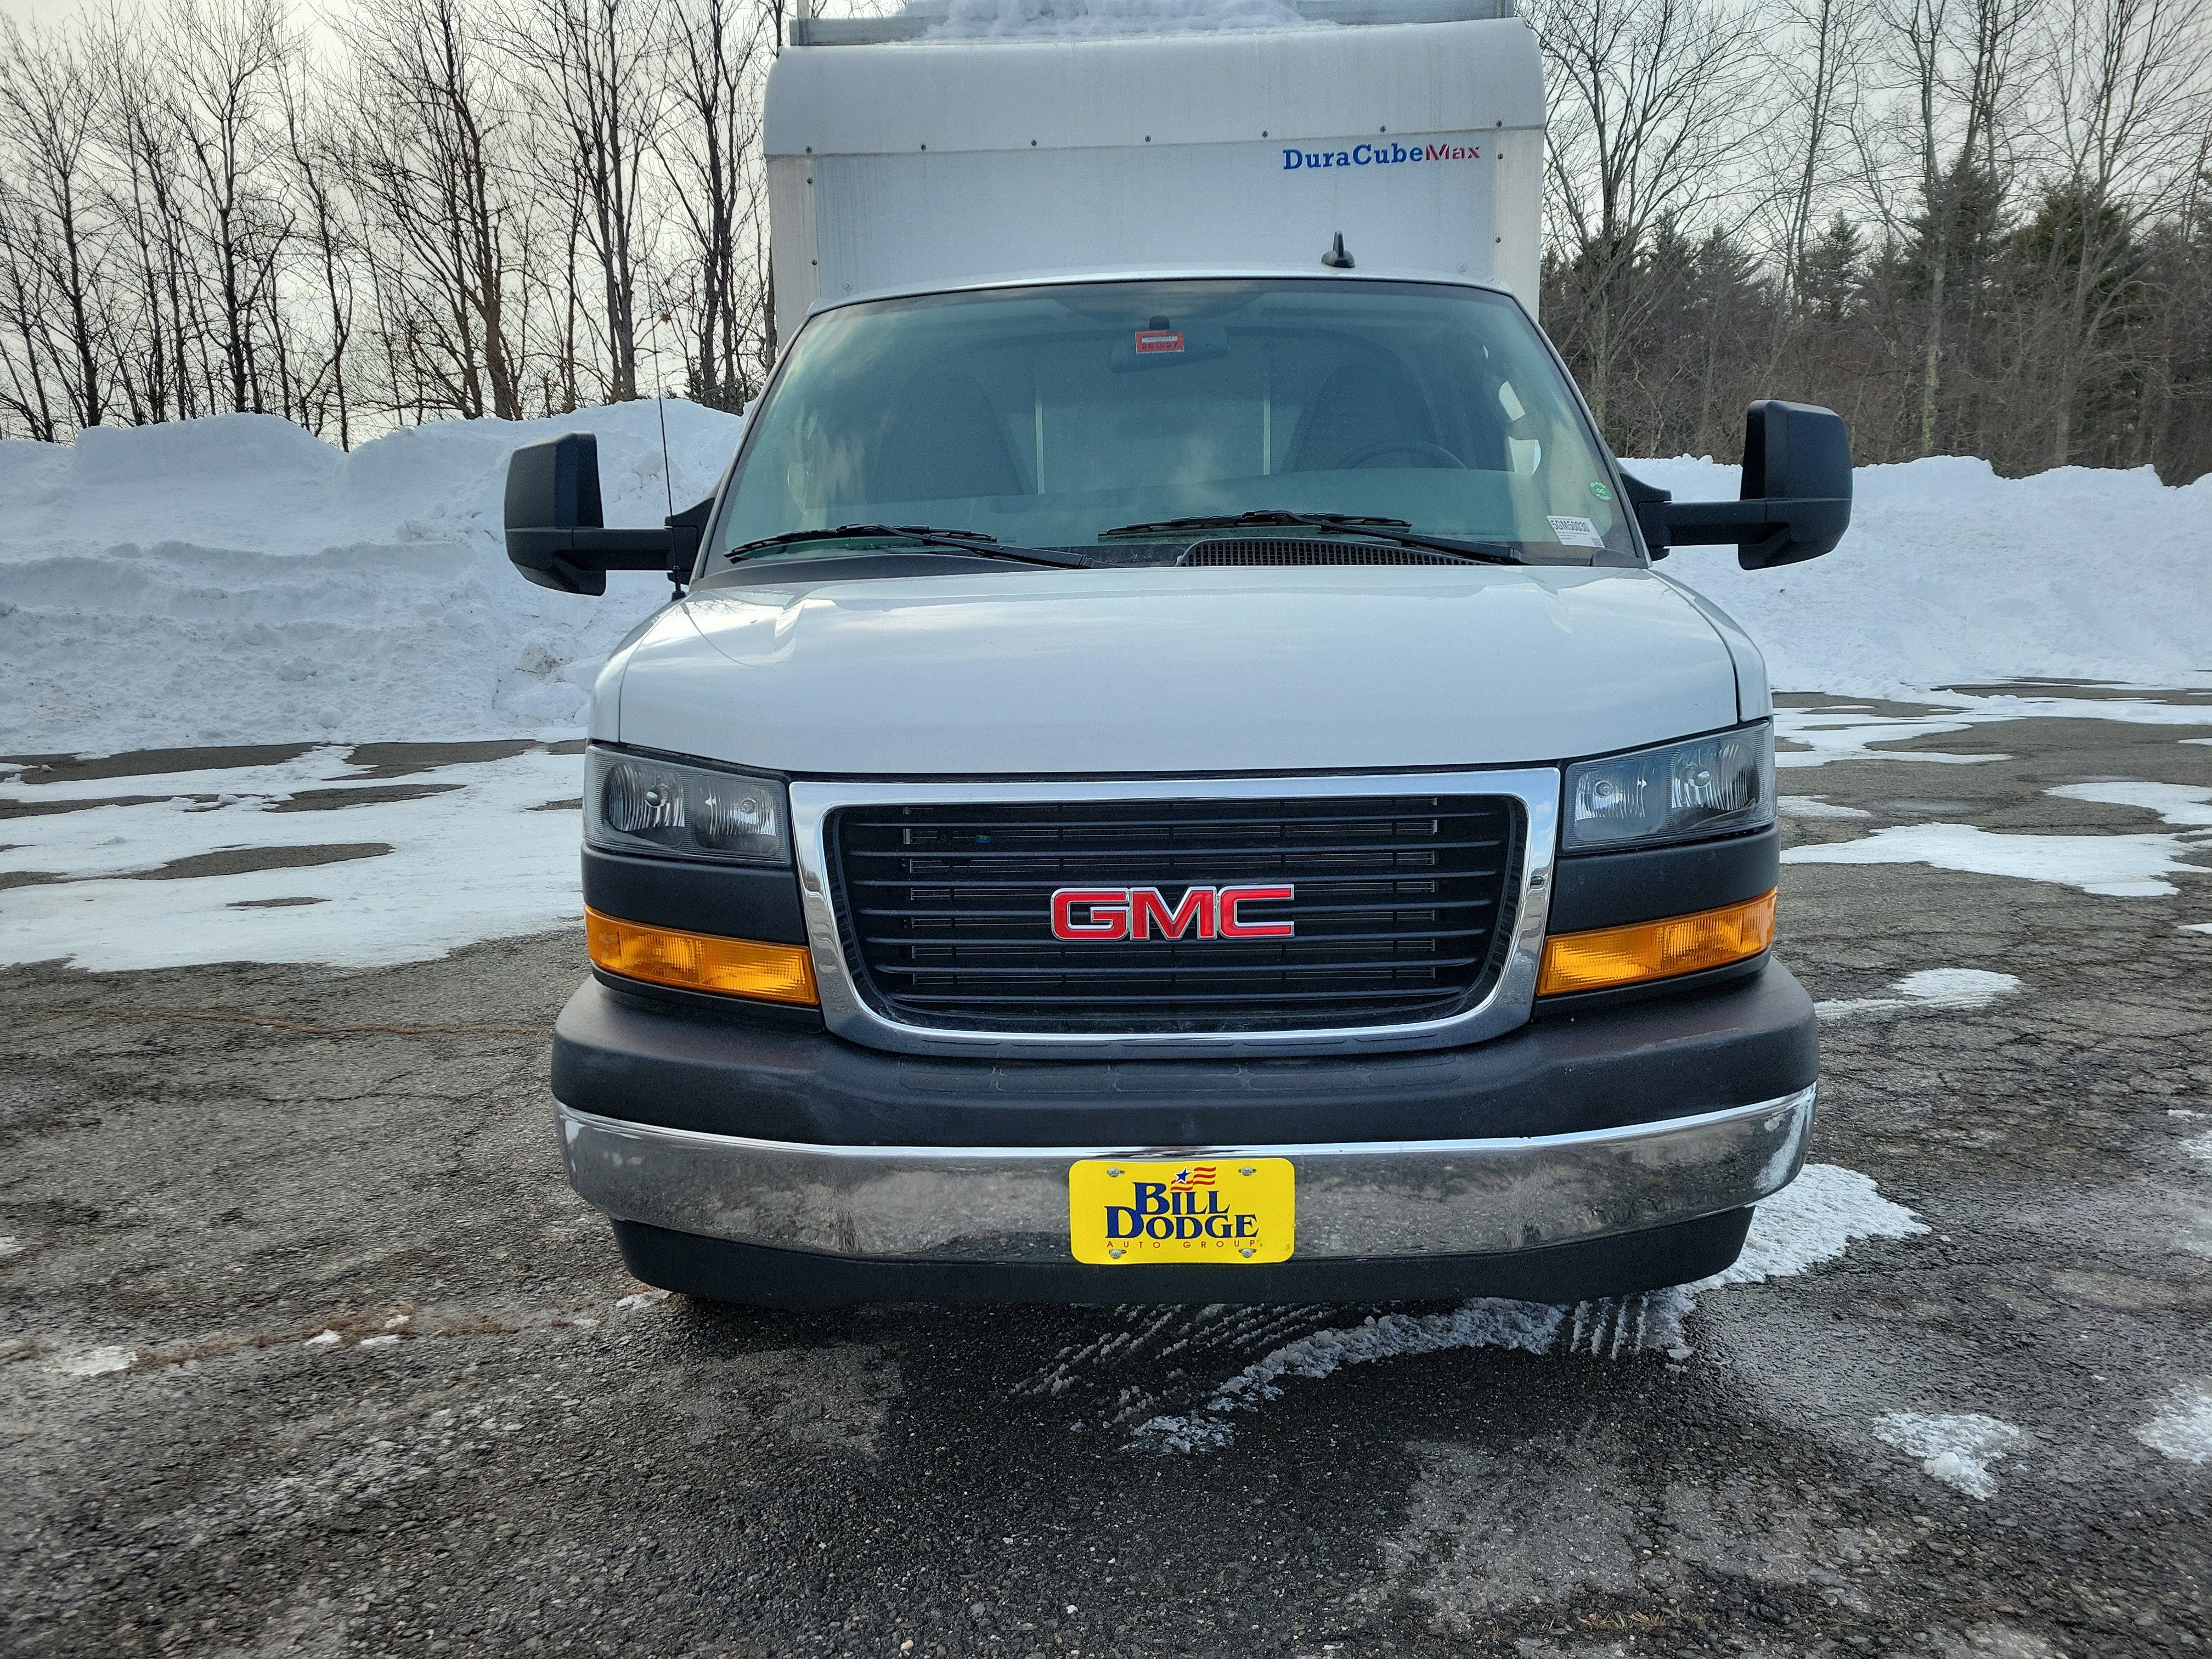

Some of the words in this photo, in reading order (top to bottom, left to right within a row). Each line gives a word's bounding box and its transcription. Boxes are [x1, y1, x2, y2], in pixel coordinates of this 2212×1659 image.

[1050, 883, 1295, 941] GMC
[1132, 1181, 1231, 1215] BILL
[1103, 1205, 1260, 1240] DODGE
[1106, 1240, 1161, 1249] AUTO
[1182, 1239, 1256, 1249] GROUP
